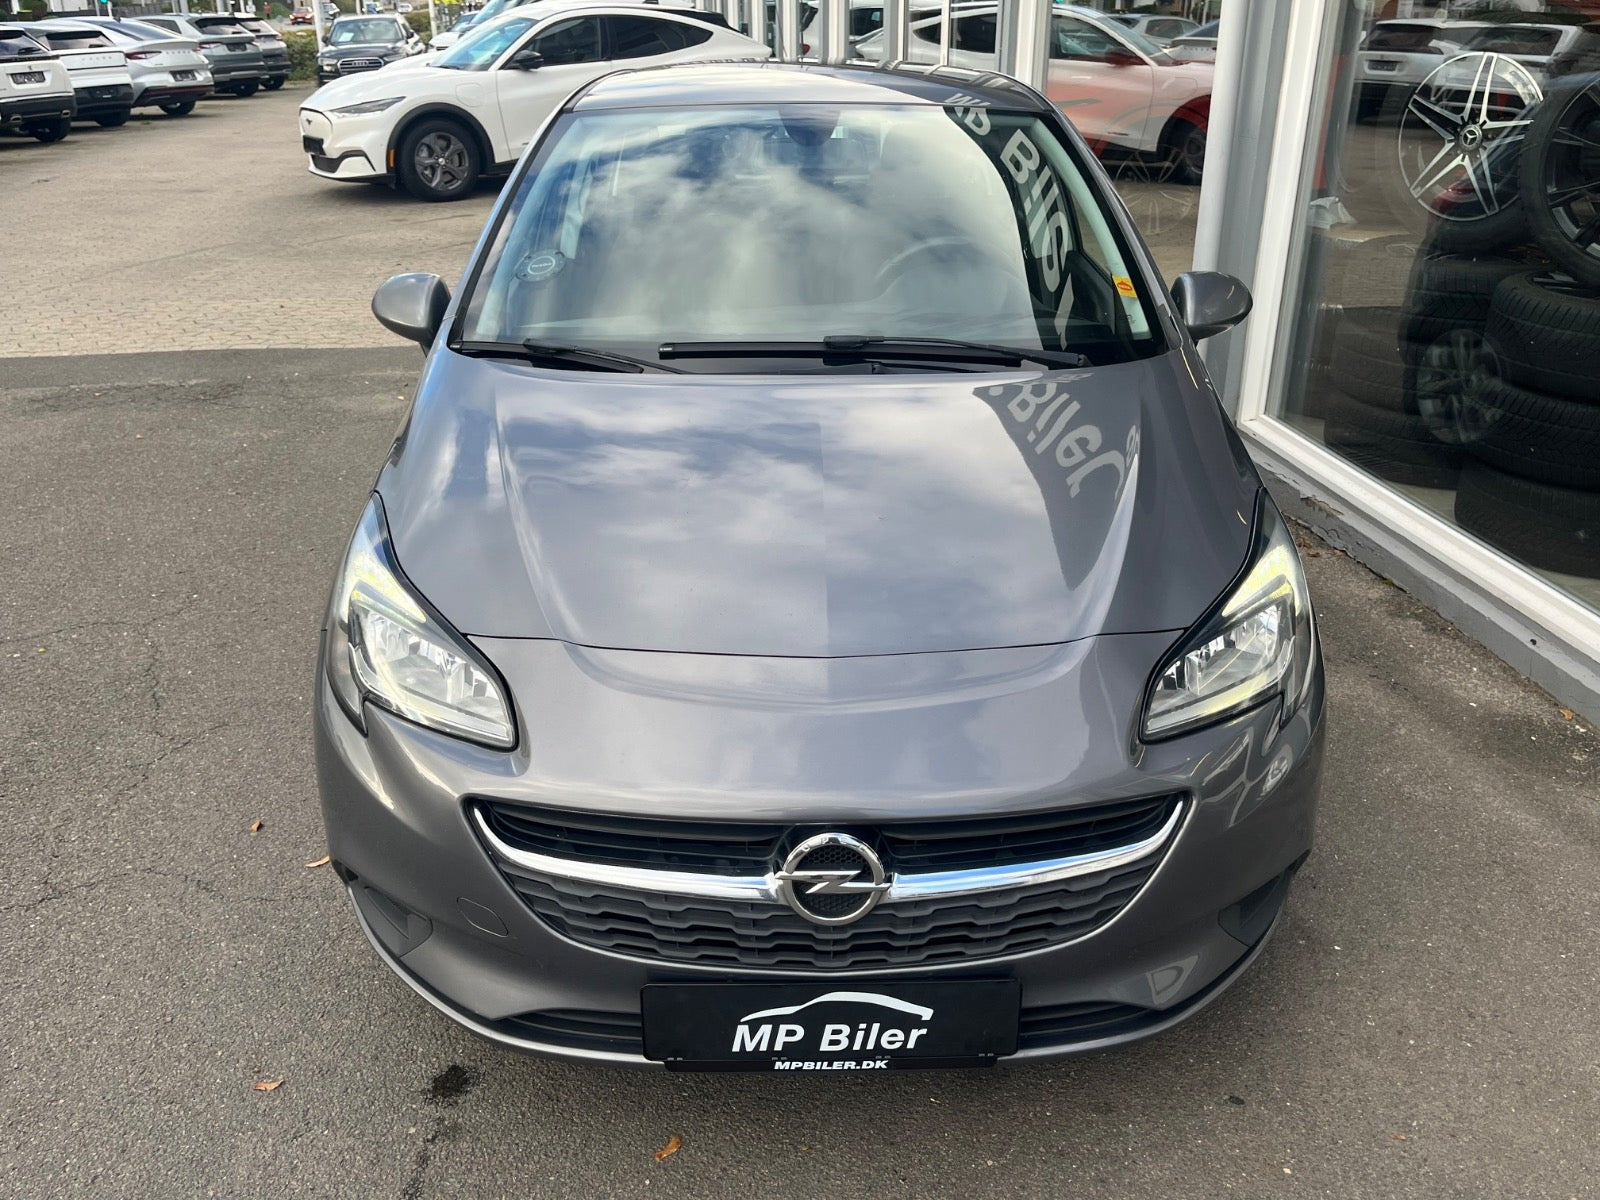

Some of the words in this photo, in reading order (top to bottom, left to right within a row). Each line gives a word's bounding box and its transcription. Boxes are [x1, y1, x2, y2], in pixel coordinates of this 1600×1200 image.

[733, 1024, 804, 1052] MP
[820, 1022, 927, 1051] Biler
[774, 1059, 888, 1070] MPBILER.DK
